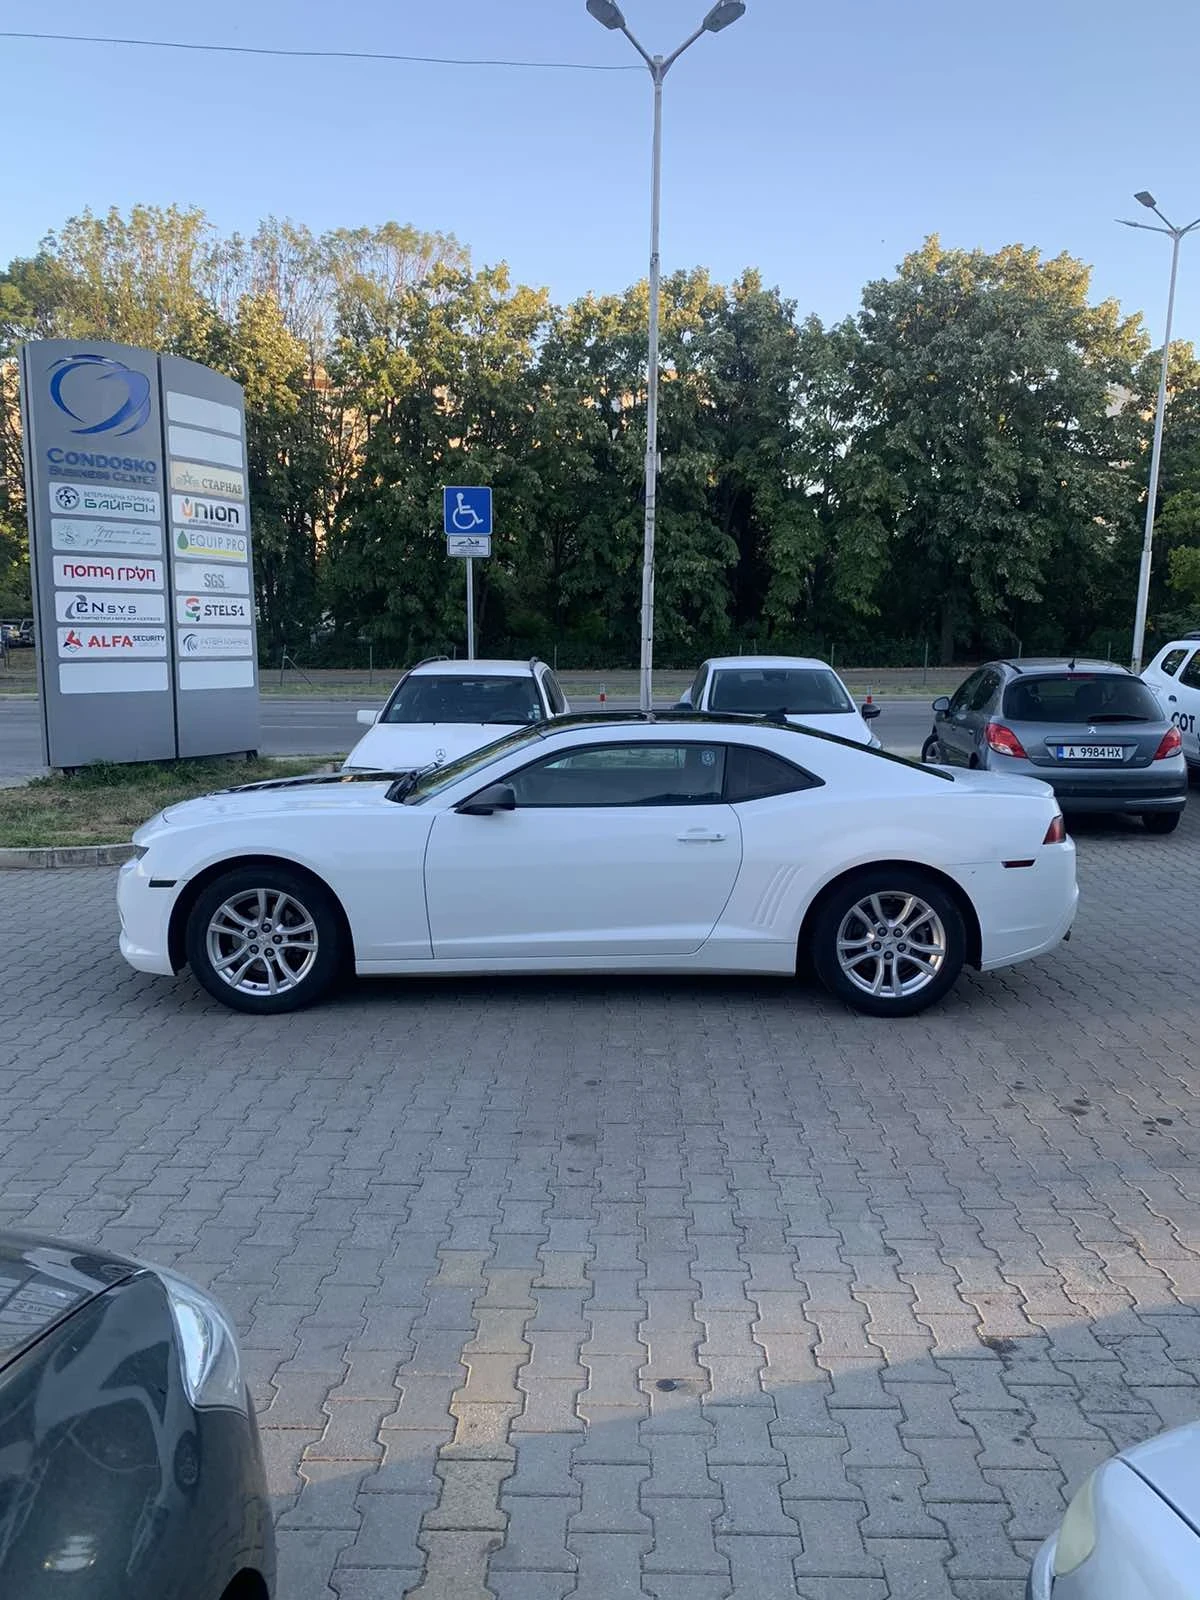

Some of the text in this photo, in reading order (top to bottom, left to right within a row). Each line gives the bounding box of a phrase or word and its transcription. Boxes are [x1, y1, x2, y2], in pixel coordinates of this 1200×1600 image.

[47, 447, 157, 474] CONDOSKO
[84, 498, 156, 513] БАЙРОН
[190, 534, 246, 552] EQUIP PRO
[203, 573, 225, 588] SGS
[88, 635, 133, 648] ALFA
[132, 634, 165, 642] SECURITY
